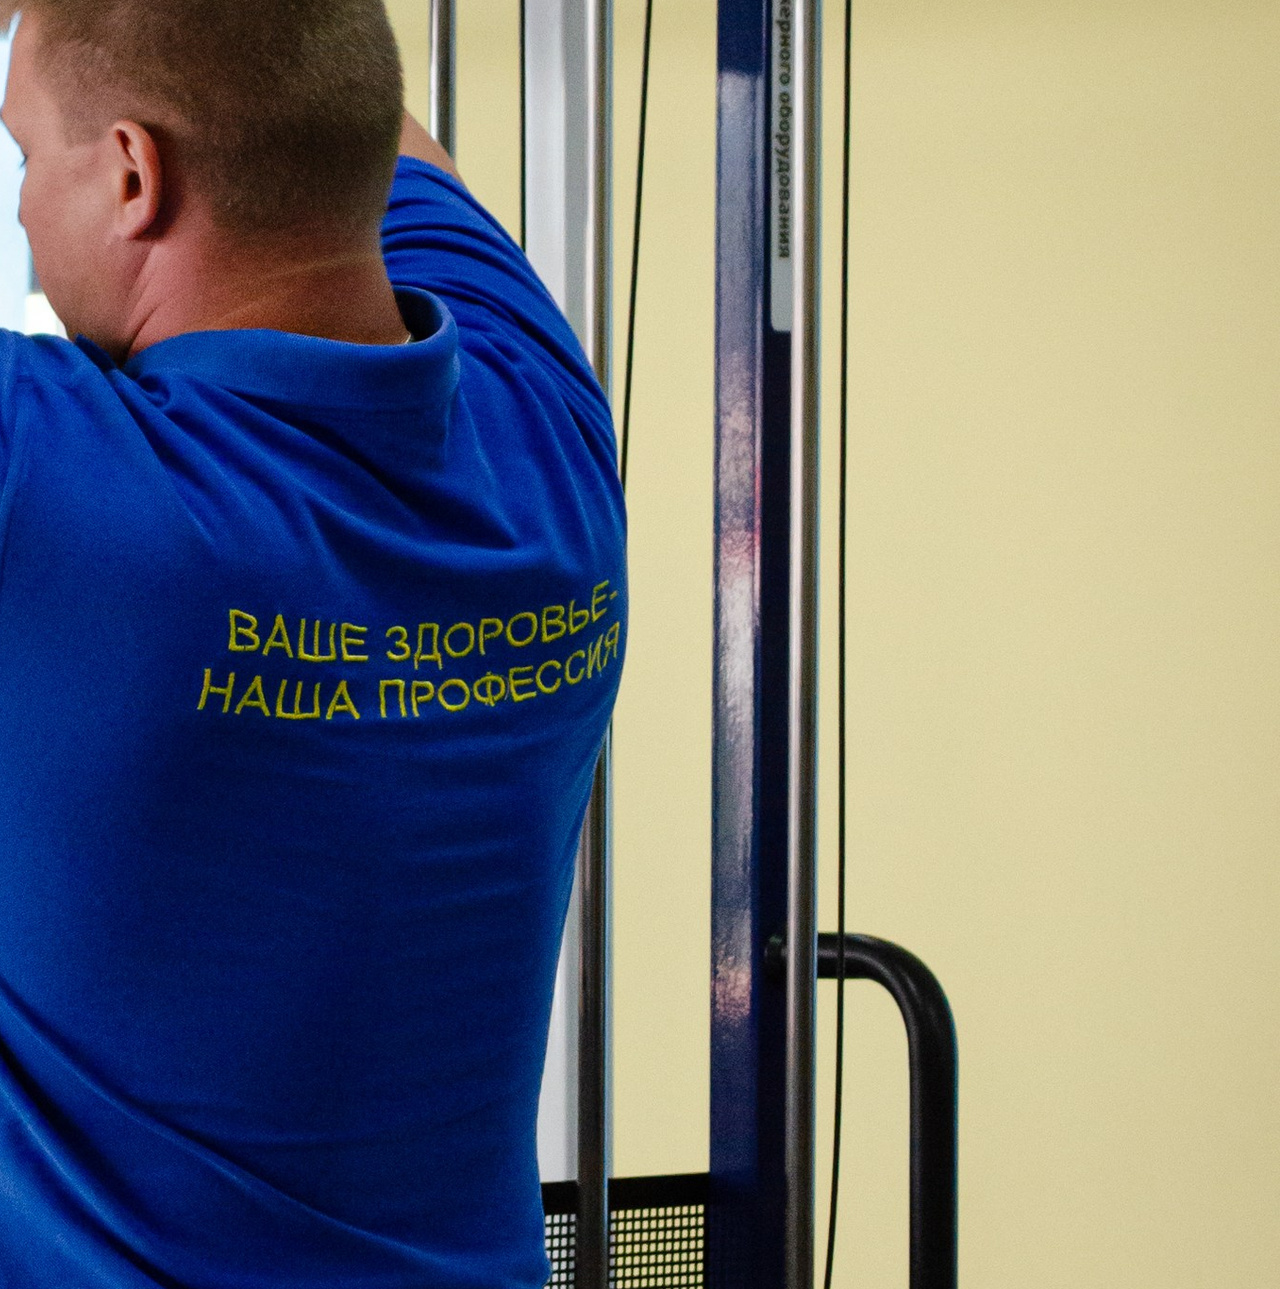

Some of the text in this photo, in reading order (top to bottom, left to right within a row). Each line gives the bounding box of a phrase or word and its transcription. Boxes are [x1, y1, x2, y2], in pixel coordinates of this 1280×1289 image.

[197, 621, 620, 720] НАША ПРОФЕССИЯ
[228, 608, 369, 662] ВАШЕ
